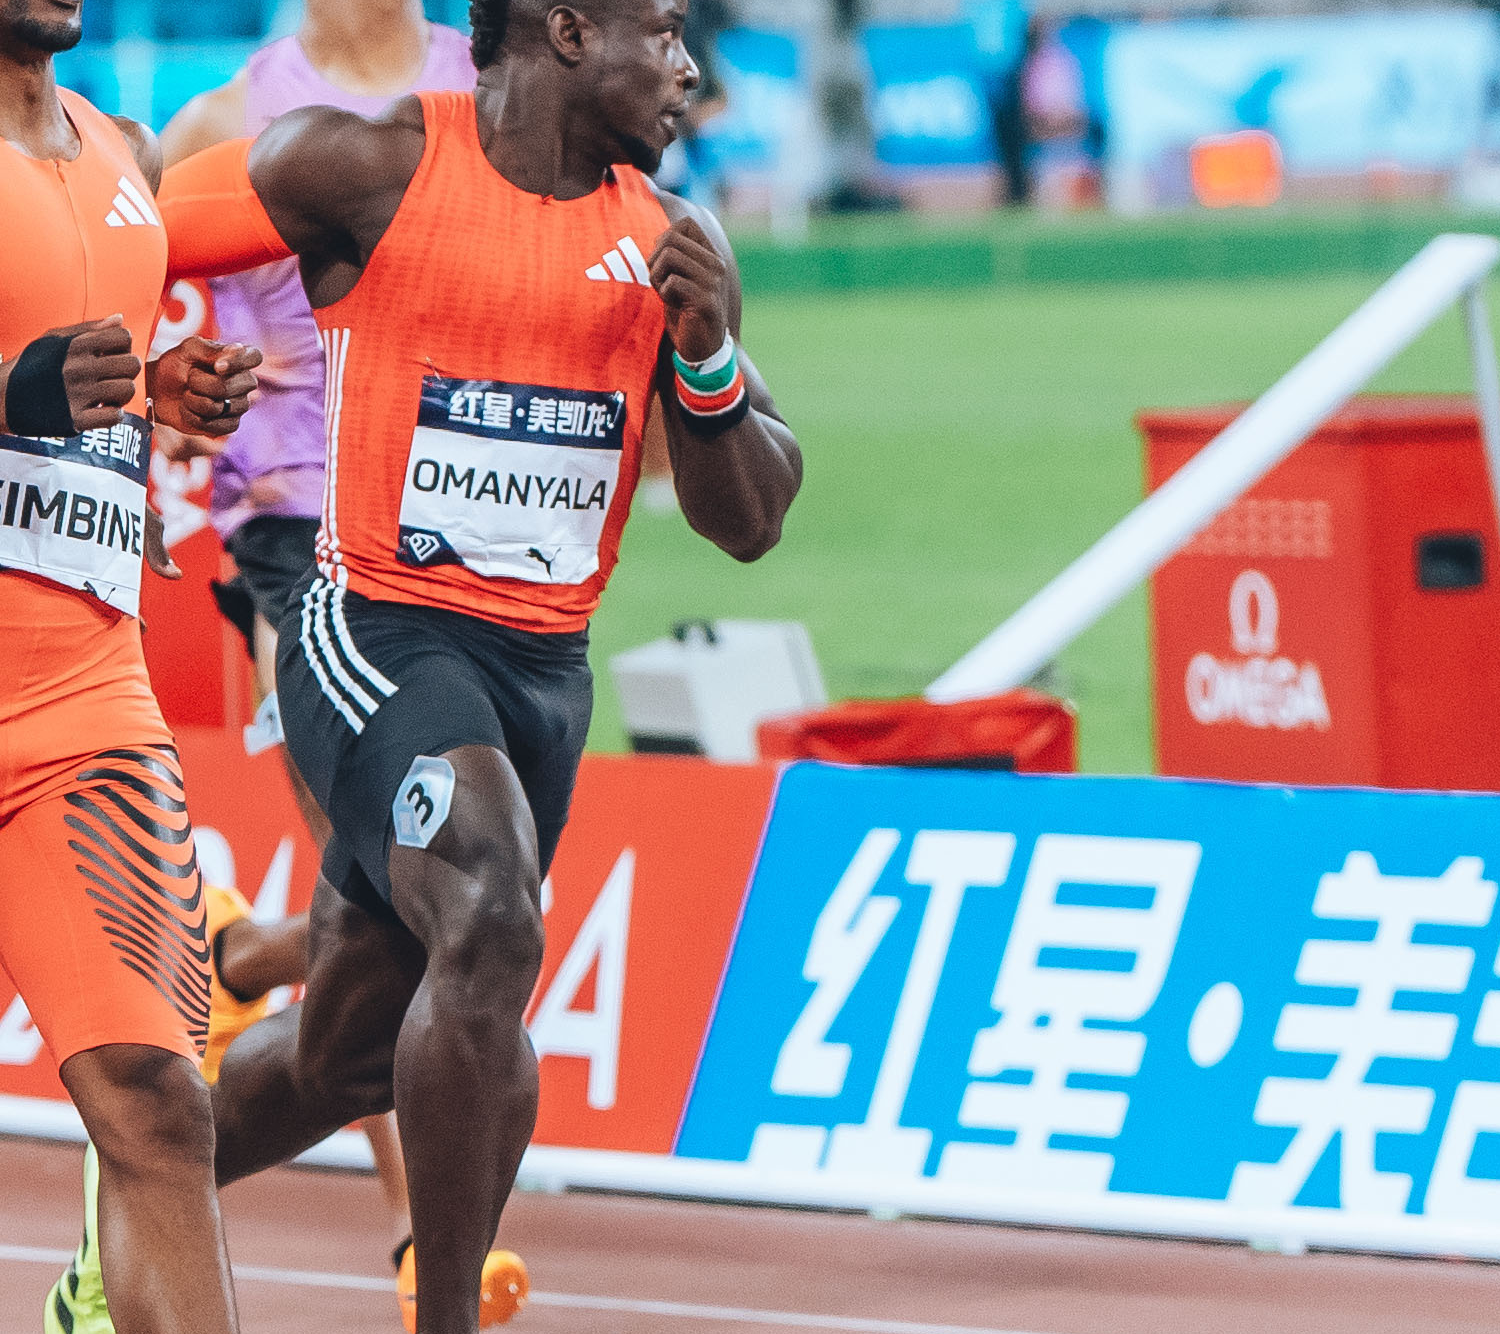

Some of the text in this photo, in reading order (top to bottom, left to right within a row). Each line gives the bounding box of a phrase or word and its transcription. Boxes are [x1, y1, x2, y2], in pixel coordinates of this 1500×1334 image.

[448, 390, 607, 438] 红星·美凯龙
[412, 457, 608, 510] OMANYALA
[406, 781, 434, 828] 3
